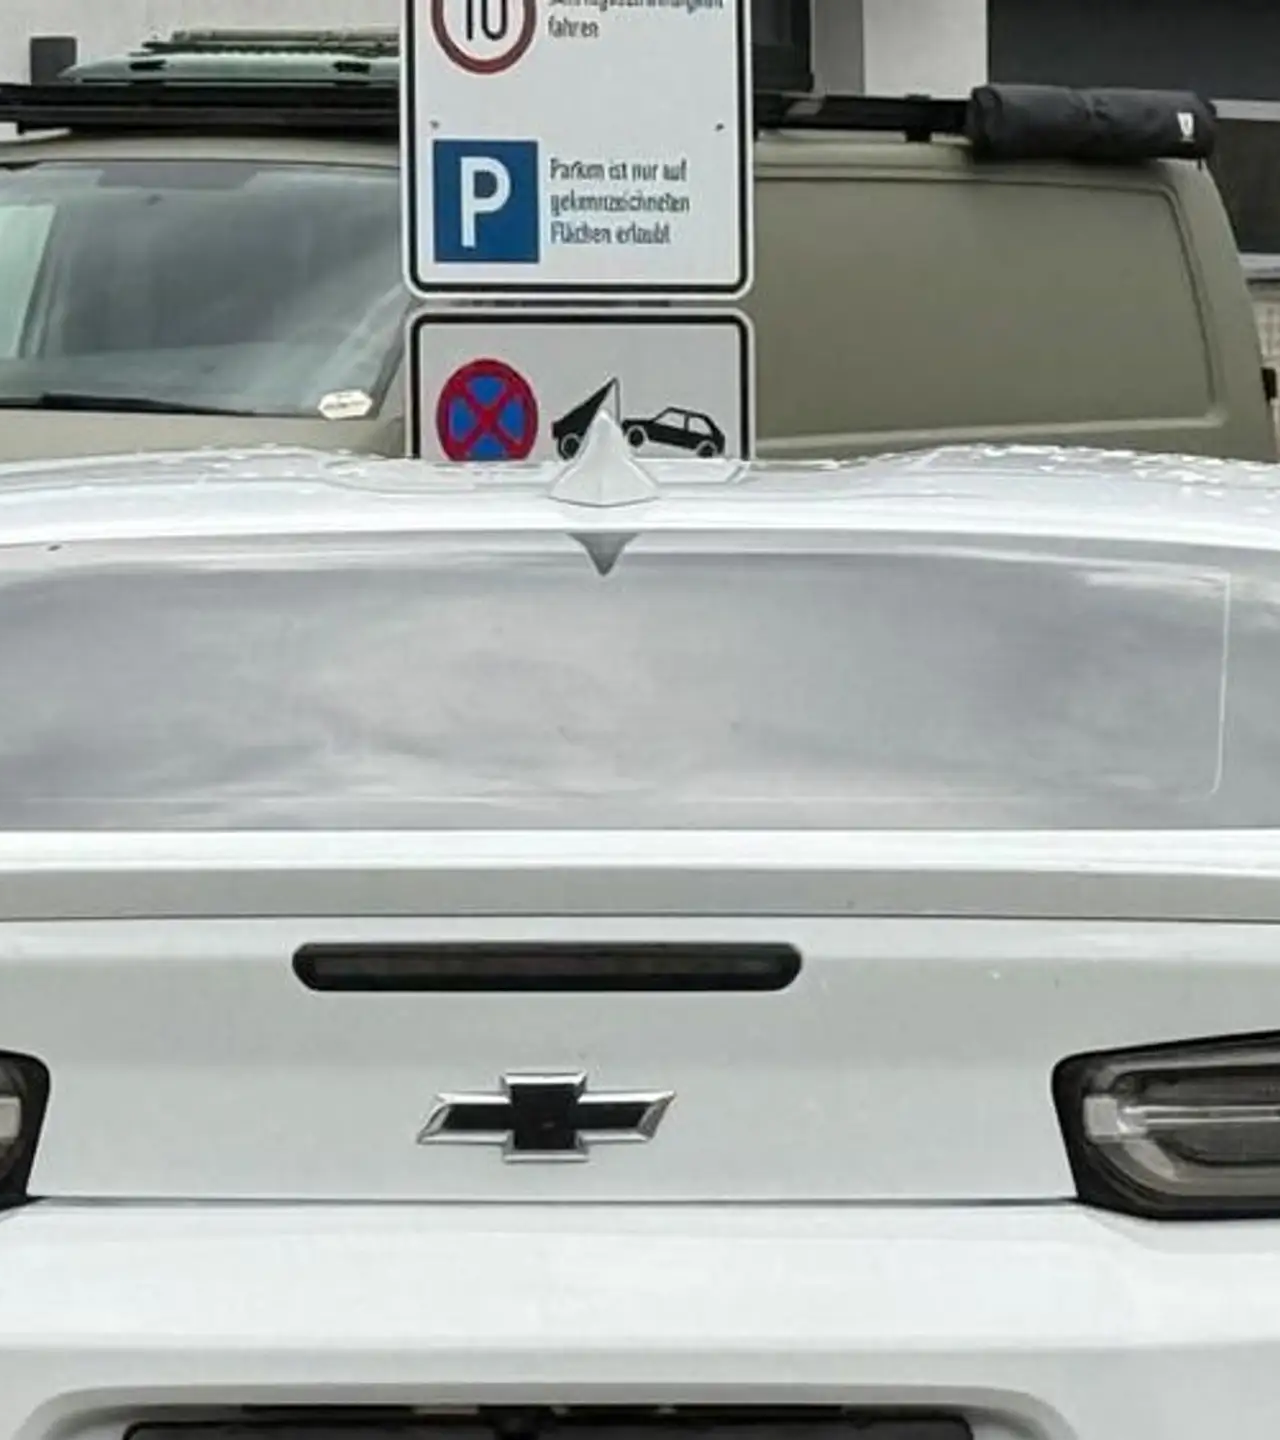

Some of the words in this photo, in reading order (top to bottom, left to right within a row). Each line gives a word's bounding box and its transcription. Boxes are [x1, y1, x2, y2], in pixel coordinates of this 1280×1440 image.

[466, 0, 507, 41] 10
[548, 15, 600, 38] fahren
[550, 158, 605, 181] Parken
[608, 160, 627, 181] ist
[631, 163, 659, 182] nur
[663, 158, 687, 181] auf
[460, 156, 511, 248] P
